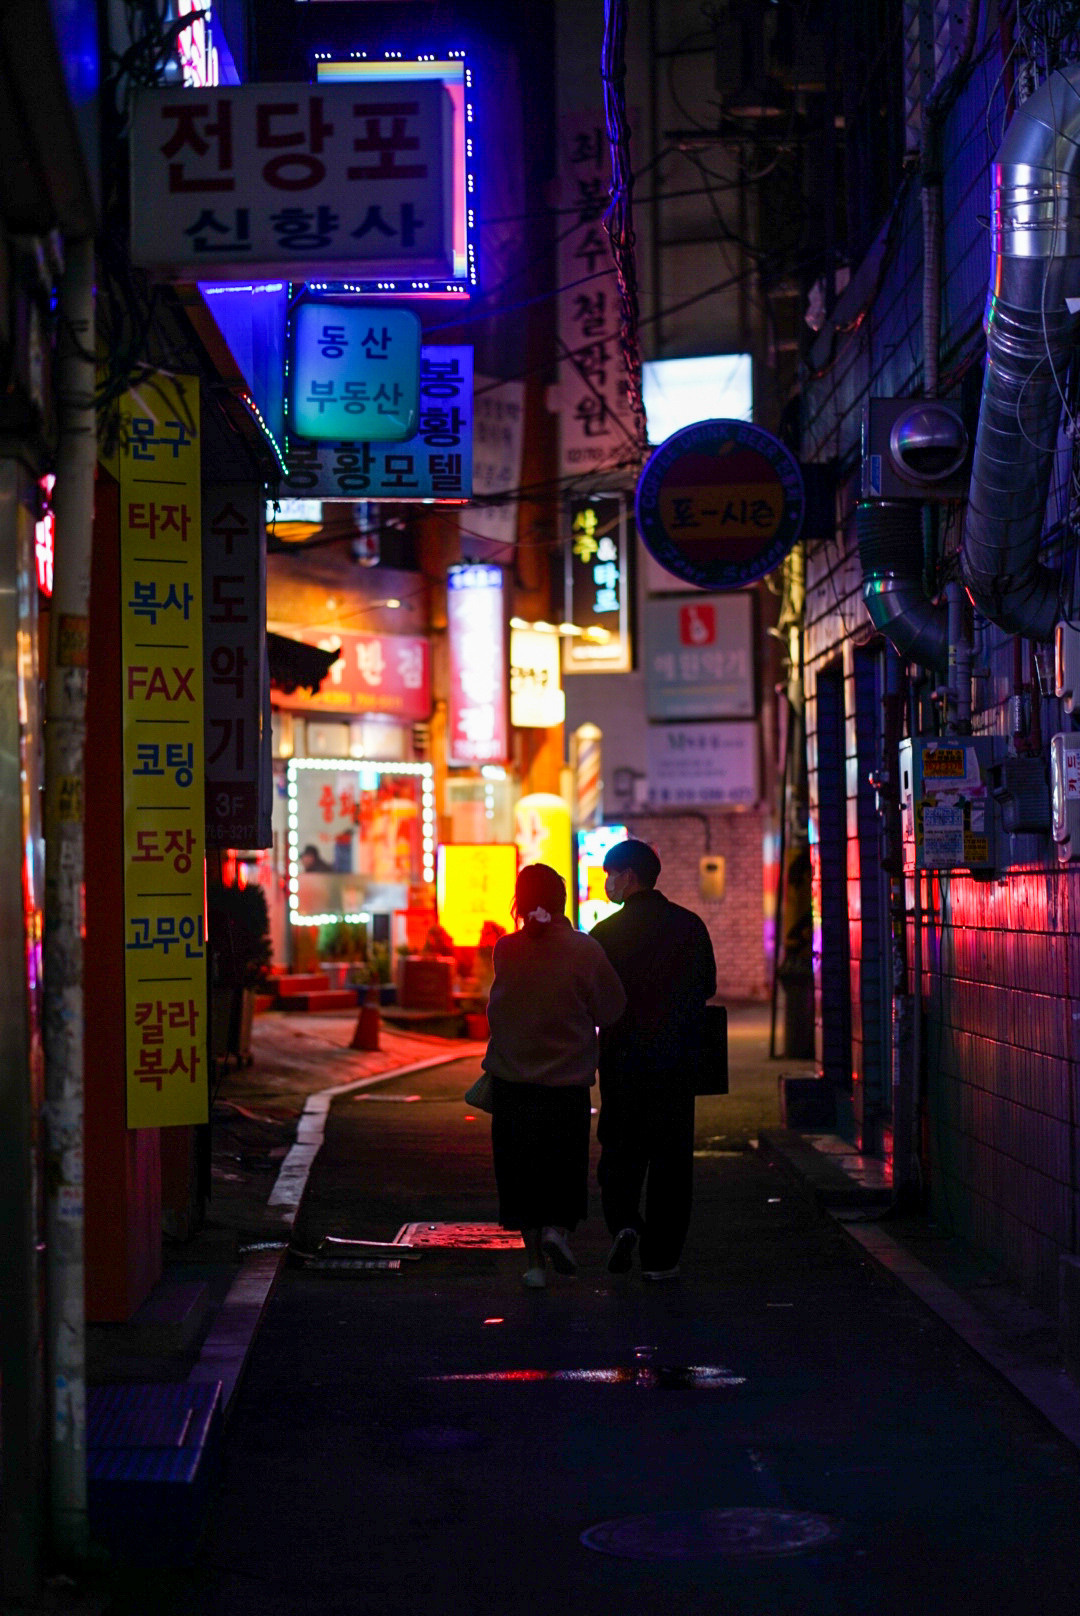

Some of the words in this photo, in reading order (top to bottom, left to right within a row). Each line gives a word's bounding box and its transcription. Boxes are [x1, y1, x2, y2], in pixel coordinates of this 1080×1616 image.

[160, 97, 428, 193] 전당포
[186, 203, 424, 253] 신향사
[306, 380, 403, 415] 부동산
[419, 358, 466, 447] 봉황
[128, 418, 191, 461] 문구
[128, 502, 192, 541] 타자
[128, 581, 193, 624] 복사
[206, 500, 249, 771] 수도악기
[127, 665, 196, 702] FAX
[132, 743, 195, 788] 코팅
[216, 793, 244, 817] 3F
[131, 830, 197, 874] 도장
[126, 915, 204, 959] 고무인
[134, 1000, 200, 1045] 칼라
[133, 1046, 201, 1092] 복사
